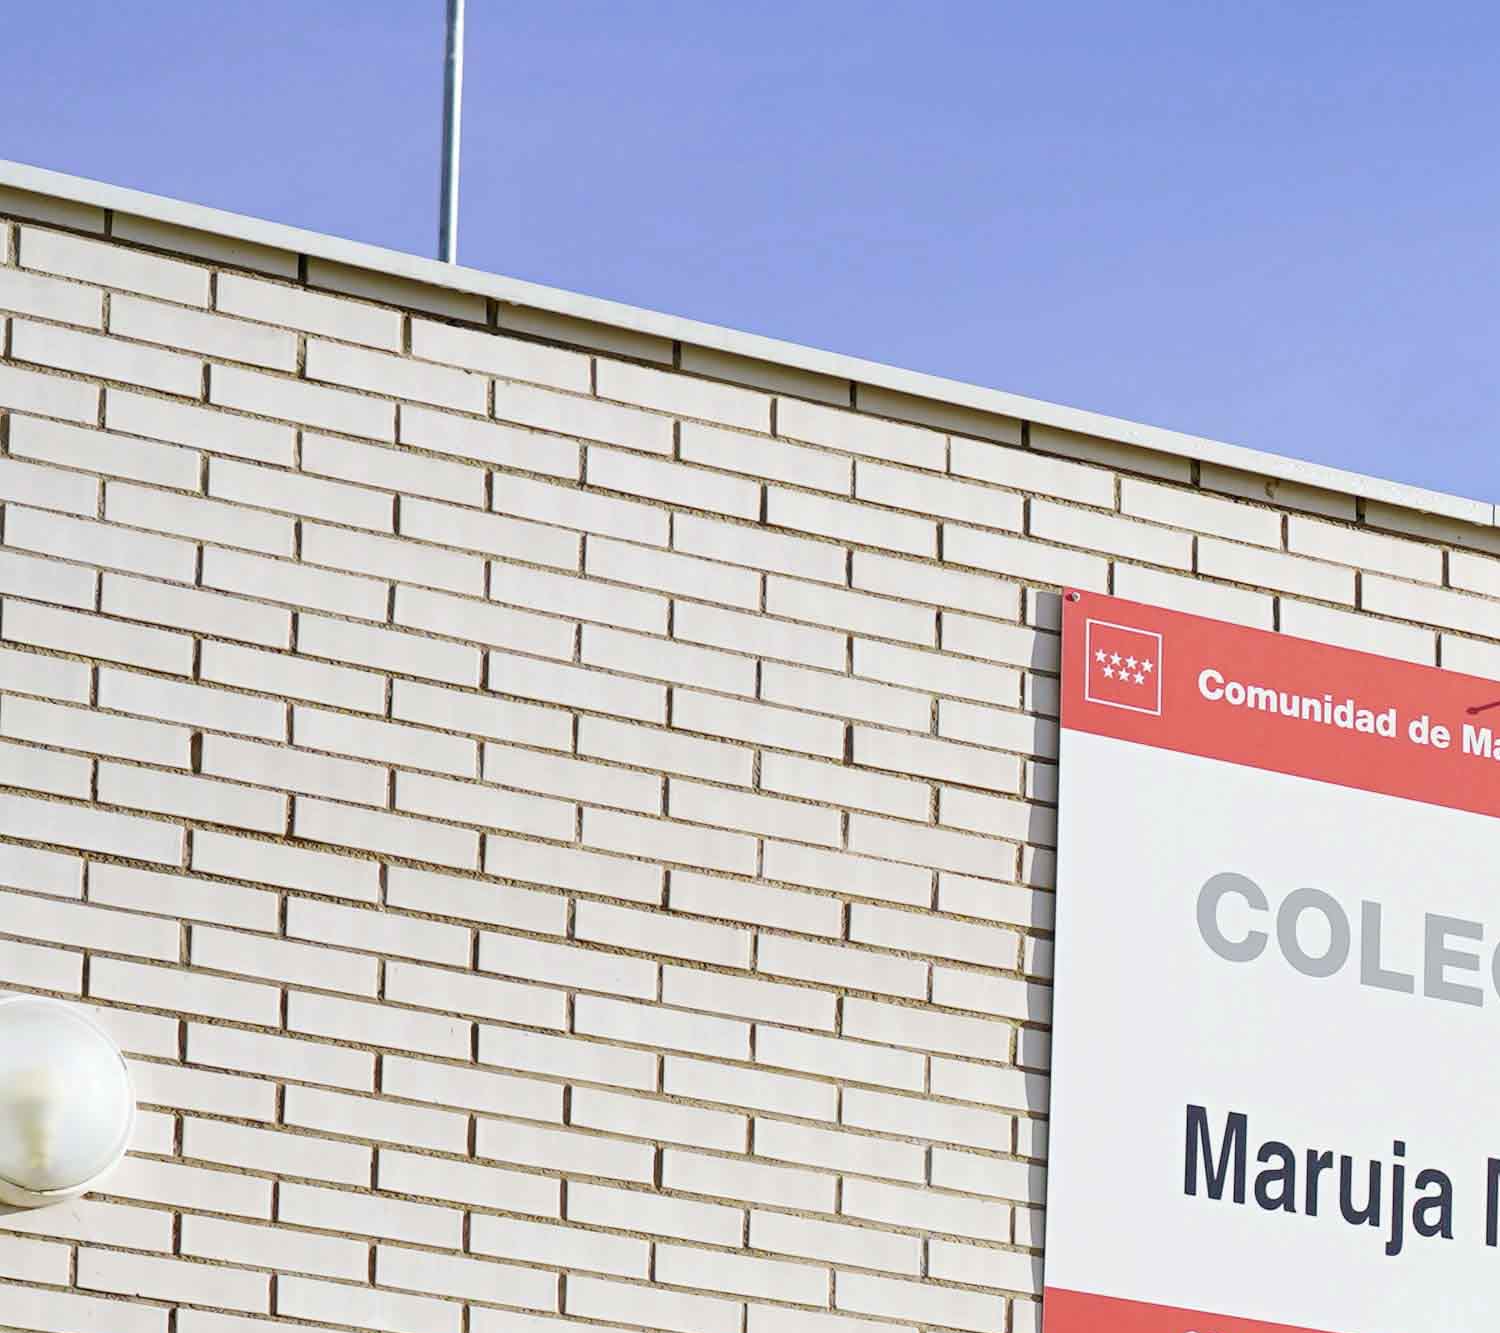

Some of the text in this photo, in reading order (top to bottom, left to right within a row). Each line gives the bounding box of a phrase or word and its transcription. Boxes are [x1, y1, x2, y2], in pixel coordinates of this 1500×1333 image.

[1198, 668, 1397, 740] Comunidad
[1408, 713, 1451, 749] de
[1183, 1103, 1453, 1256] Maruja
